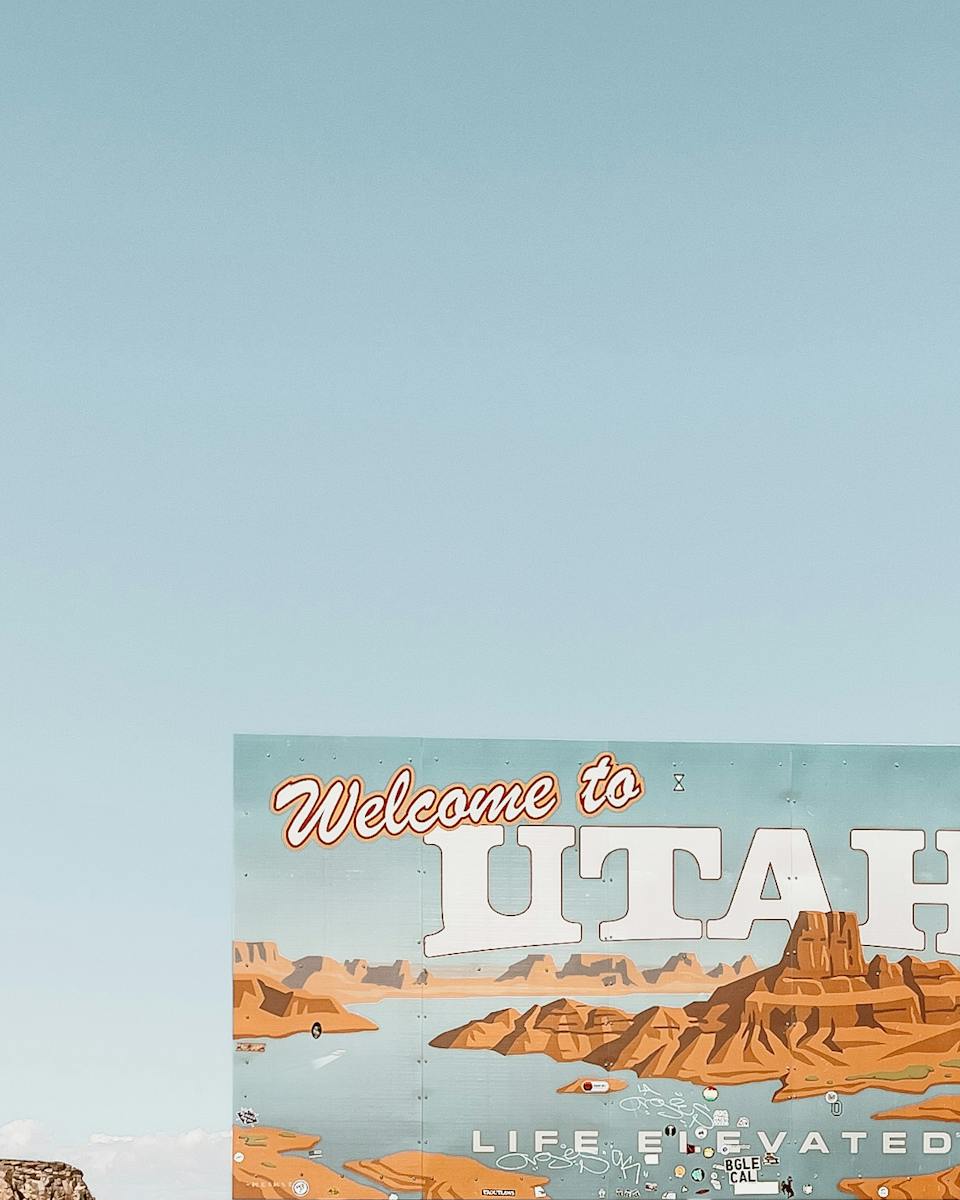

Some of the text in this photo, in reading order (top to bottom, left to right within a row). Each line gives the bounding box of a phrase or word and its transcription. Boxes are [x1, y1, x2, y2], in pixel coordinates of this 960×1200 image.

[273, 753, 643, 849] Welcome to
[472, 1130, 599, 1154] LIFE
[638, 1130, 953, 1154] ELEVATED
[725, 1157, 760, 1171] BGLE
[730, 1170, 756, 1183] CAL
